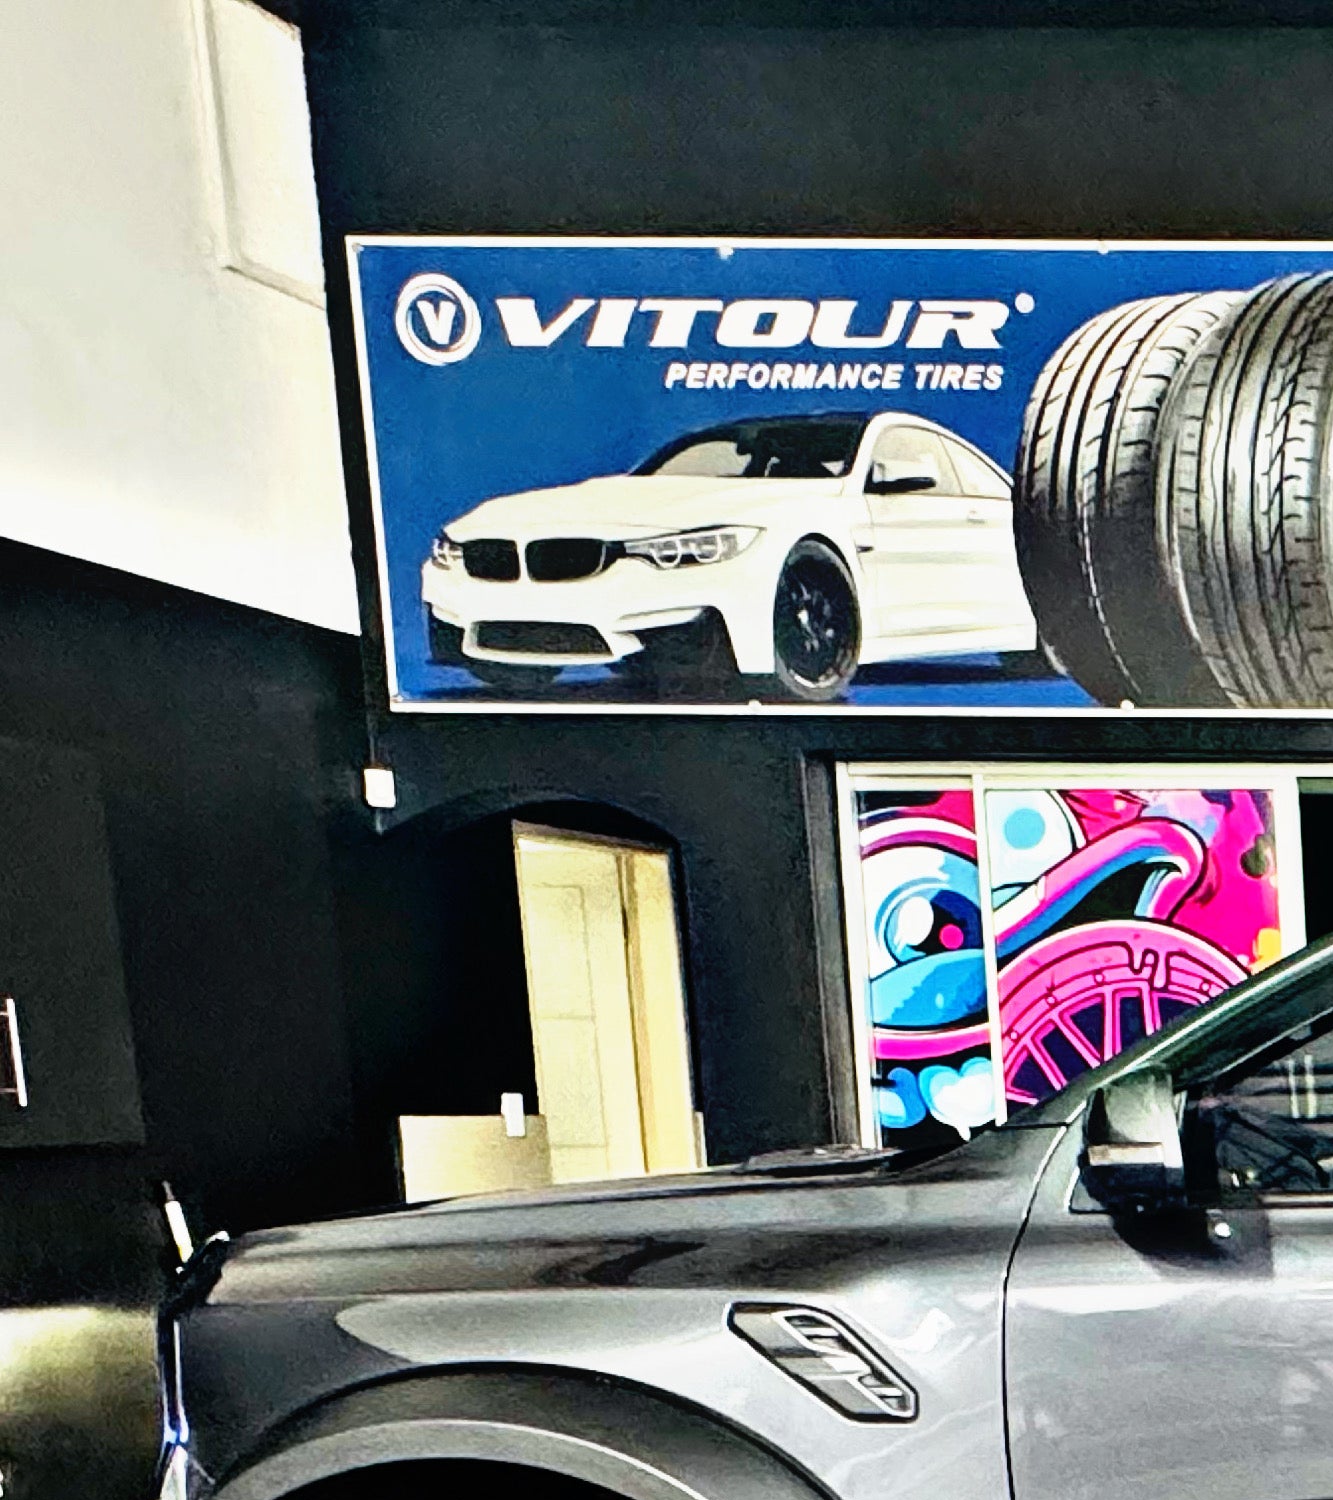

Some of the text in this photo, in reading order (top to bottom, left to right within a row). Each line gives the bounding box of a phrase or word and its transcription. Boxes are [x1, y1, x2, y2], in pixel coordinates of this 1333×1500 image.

[495, 298, 1010, 349] VITOUR
[665, 362, 1004, 391] PERFORMANCE TIRES
